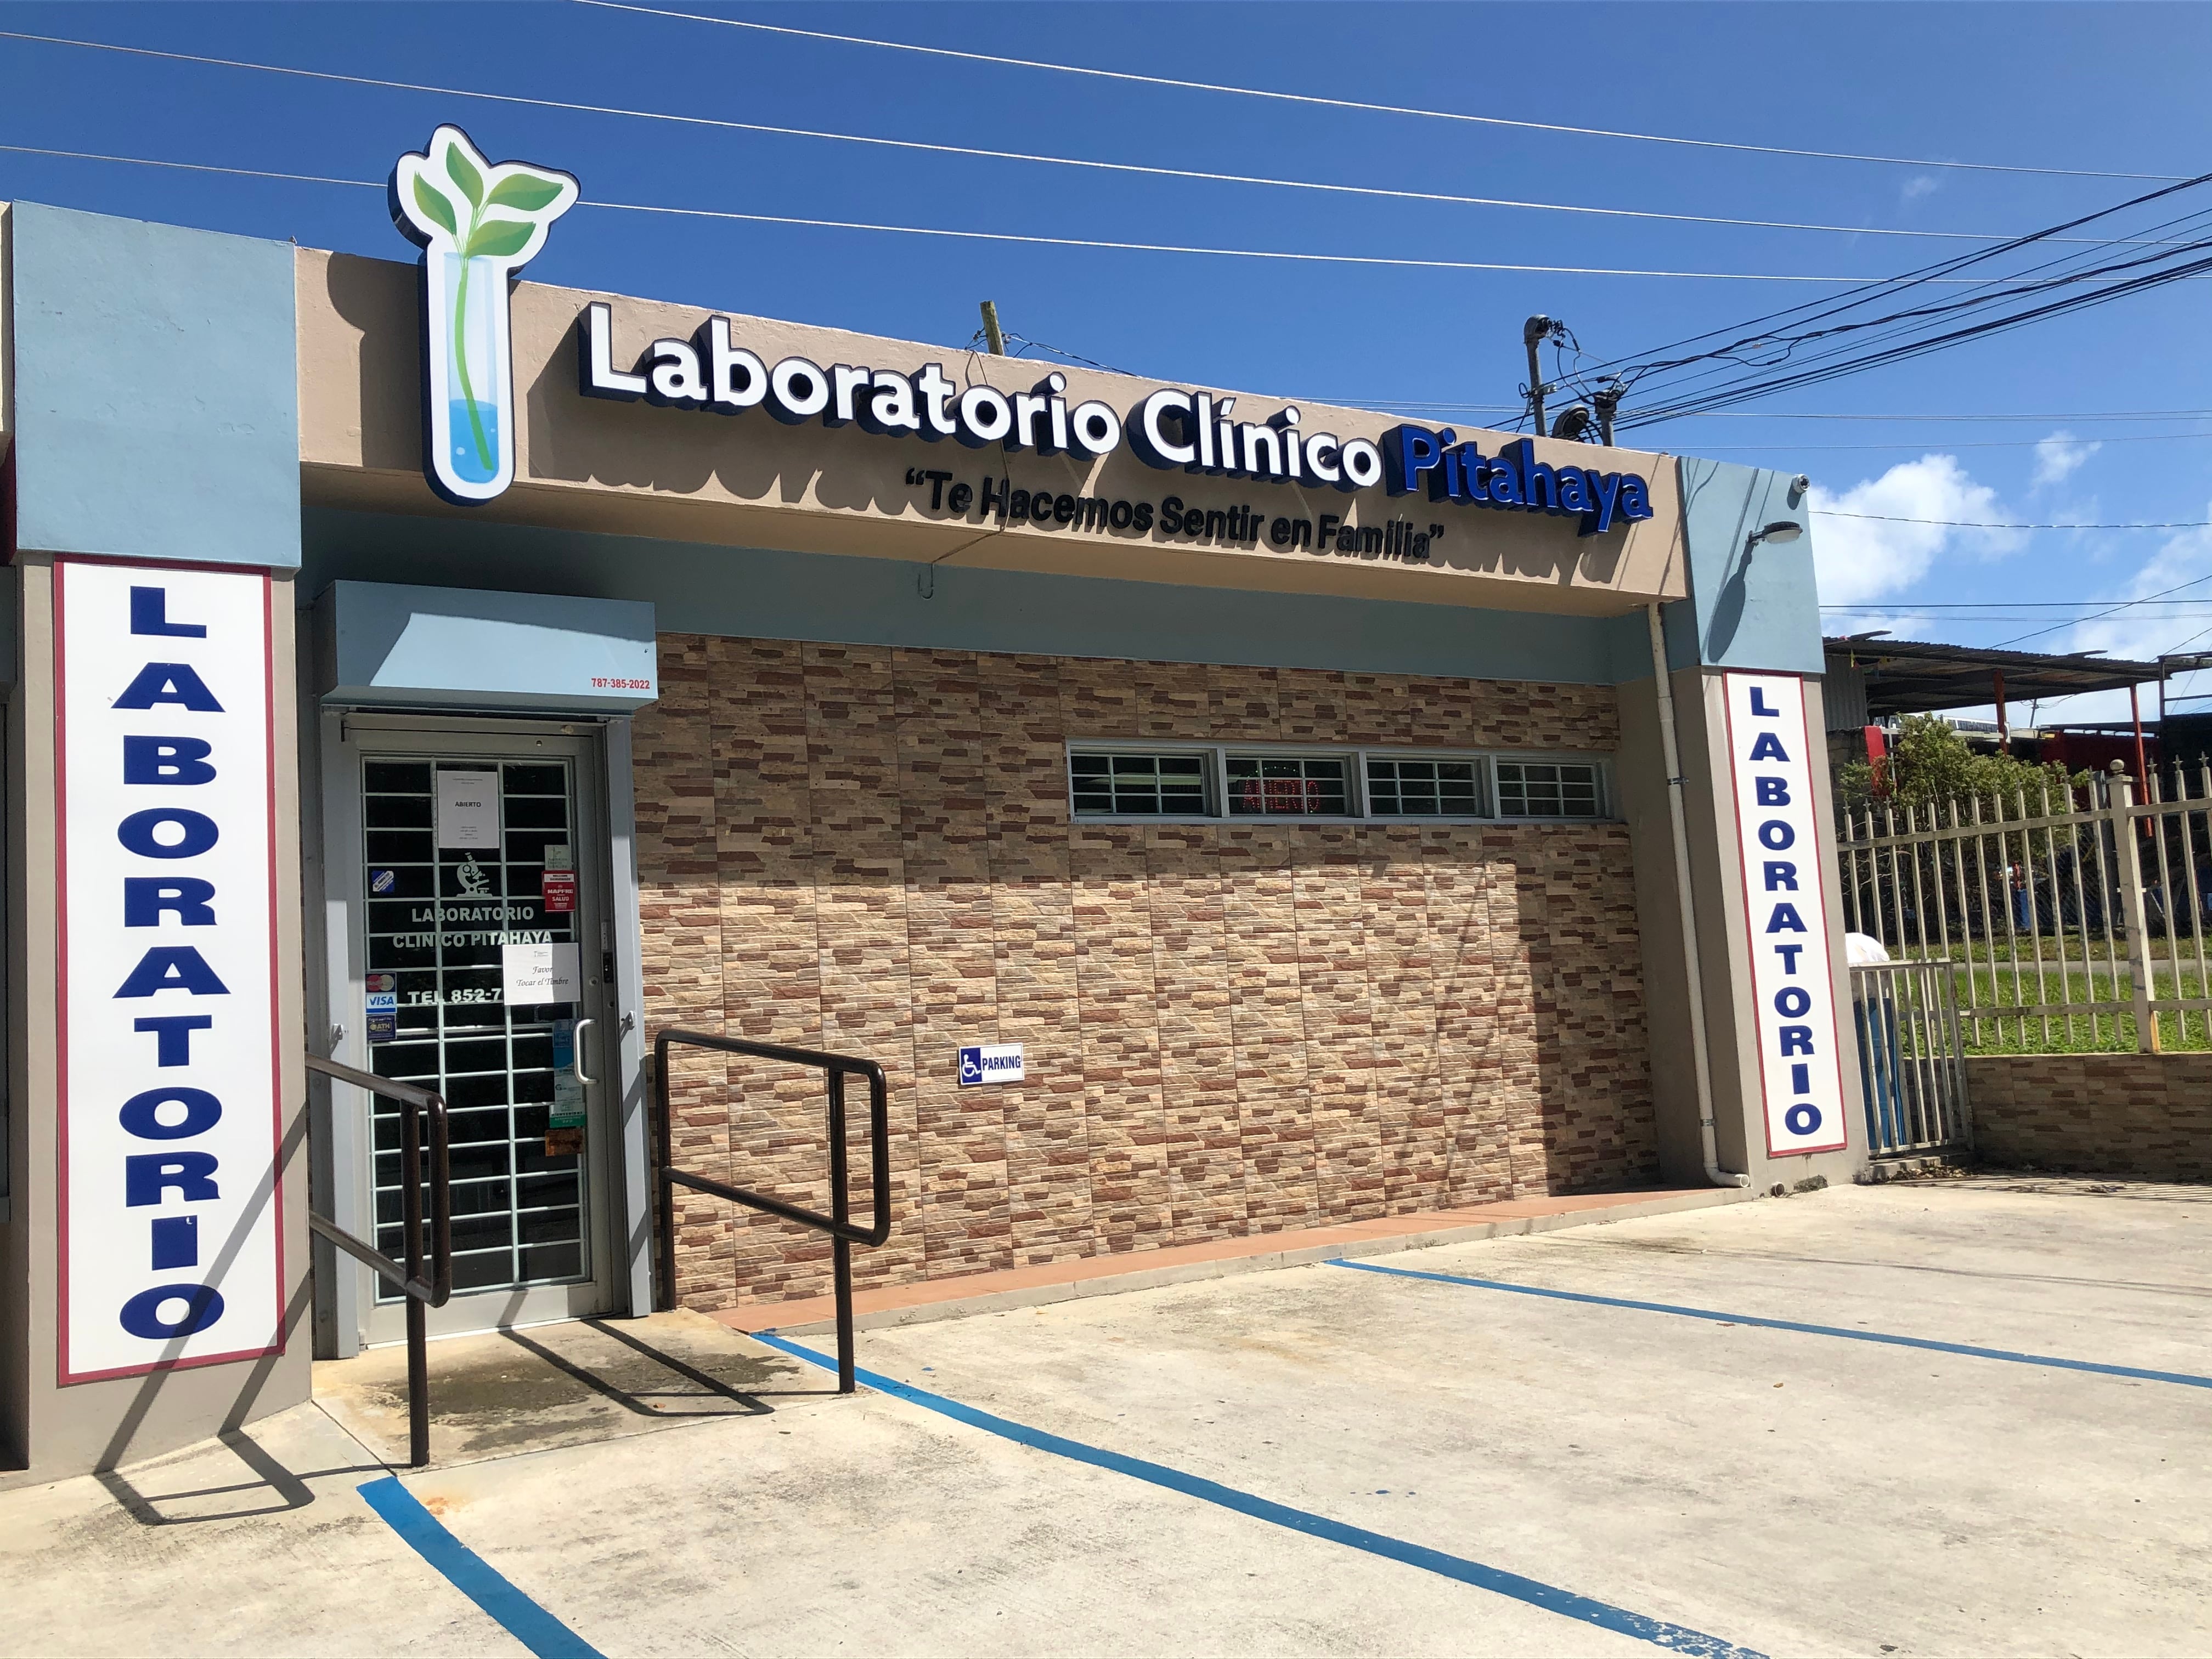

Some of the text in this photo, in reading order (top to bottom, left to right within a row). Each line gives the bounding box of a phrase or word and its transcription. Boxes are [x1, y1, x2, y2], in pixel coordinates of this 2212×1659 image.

[584, 301, 1654, 535] Laboratorio Clínico Pitahaya
[981, 477, 1154, 532] Hacemos
[1160, 496, 1264, 541] Sentir
[1271, 517, 1312, 547] en
[591, 678, 650, 689] 787-385-2022
[412, 906, 534, 922] LABORATORIO
[1748, 687, 1822, 1135] LABORATORIO
[471, 931, 552, 946] PITAHAYA
[110, 586, 231, 1340] LABORATORIO
[532, 966, 552, 974] Favor
[370, 996, 394, 1005] VISA
[982, 1056, 1021, 1070] PARKING
